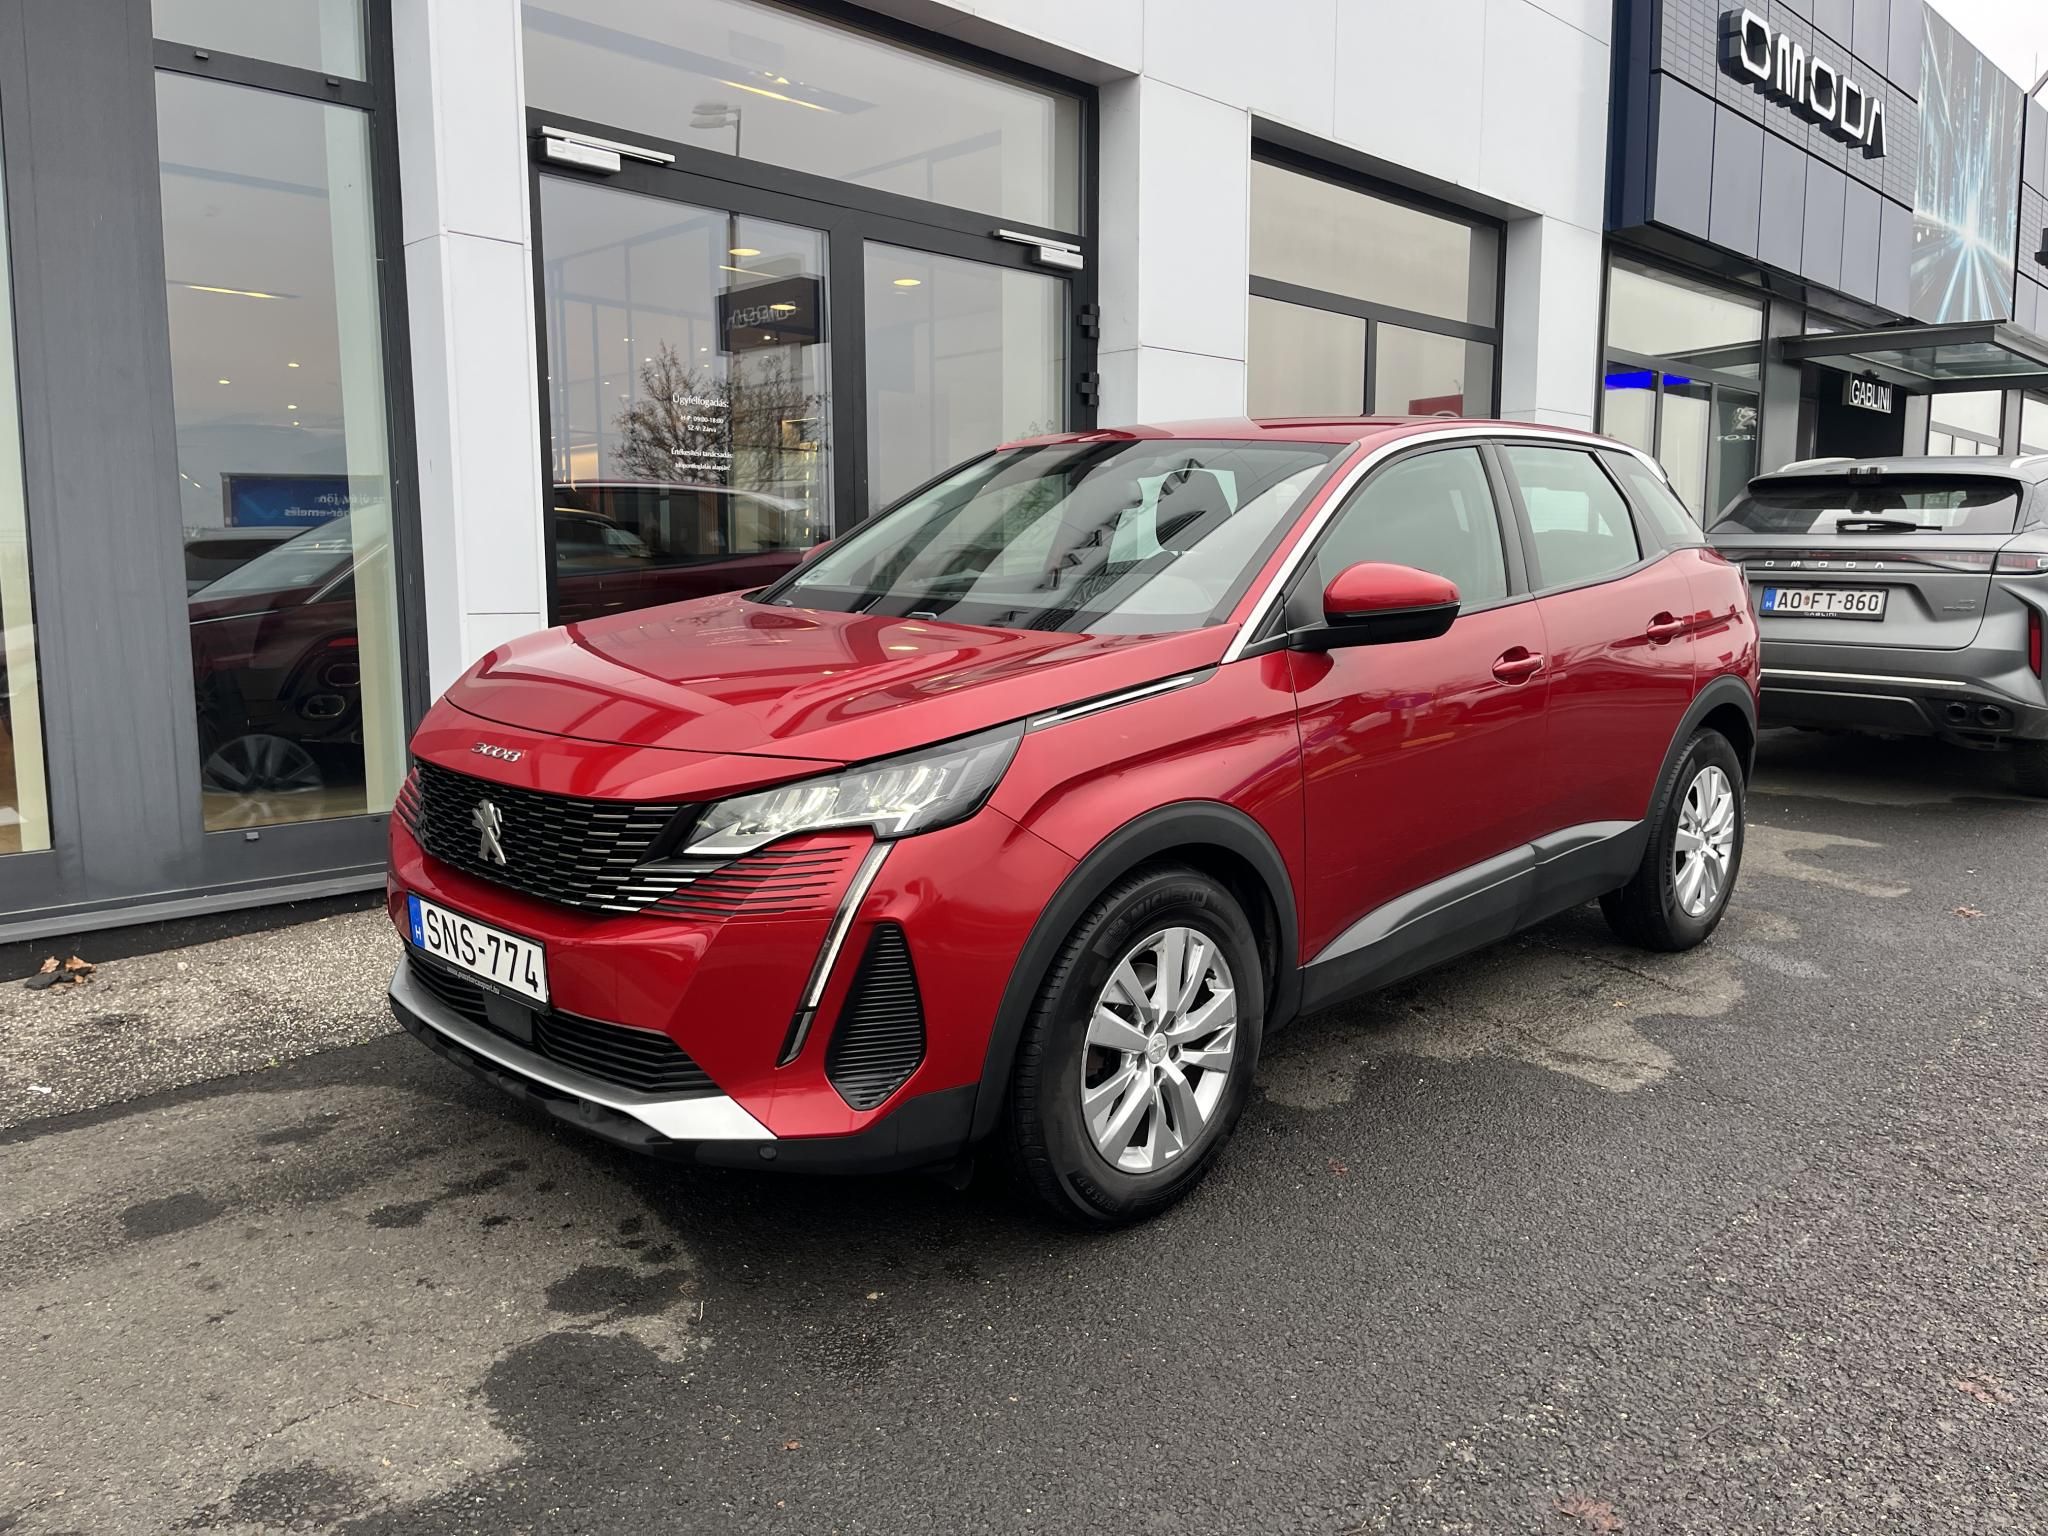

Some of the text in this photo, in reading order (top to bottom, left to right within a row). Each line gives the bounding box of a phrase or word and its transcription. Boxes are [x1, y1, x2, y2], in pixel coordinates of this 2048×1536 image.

[1740, 8, 1887, 157] OMODA
[1851, 380, 1891, 410] GABLINI
[1765, 561, 1884, 569] OMODA
[471, 742, 522, 762] 3008
[415, 925, 422, 938] H
[426, 909, 539, 993] SNS-774
